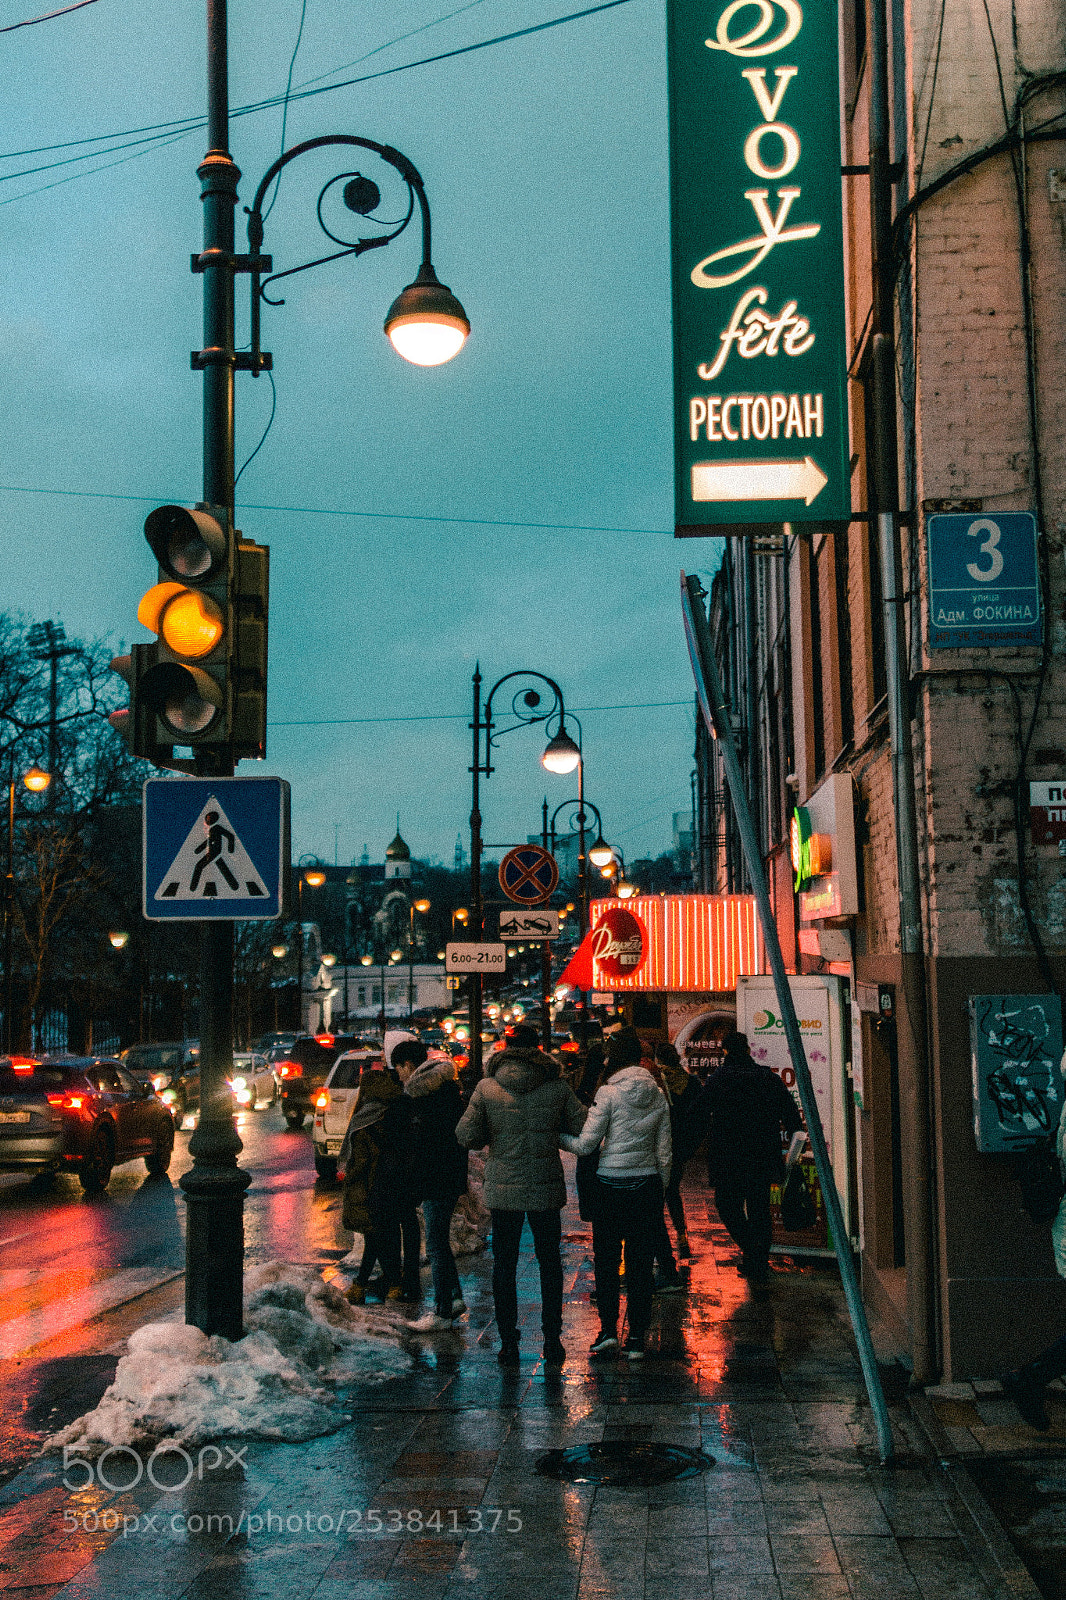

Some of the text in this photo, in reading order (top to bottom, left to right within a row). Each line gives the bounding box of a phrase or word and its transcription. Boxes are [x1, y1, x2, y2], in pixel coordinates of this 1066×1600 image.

[697, 286, 816, 381] fête
[689, 394, 824, 442] РЕСТОРАН
[966, 518, 1004, 582] 3
[937, 604, 1034, 625] Адм. ФОКИНА
[972, 593, 1000, 604] улица
[451, 952, 503, 963] 6.00-21.00
